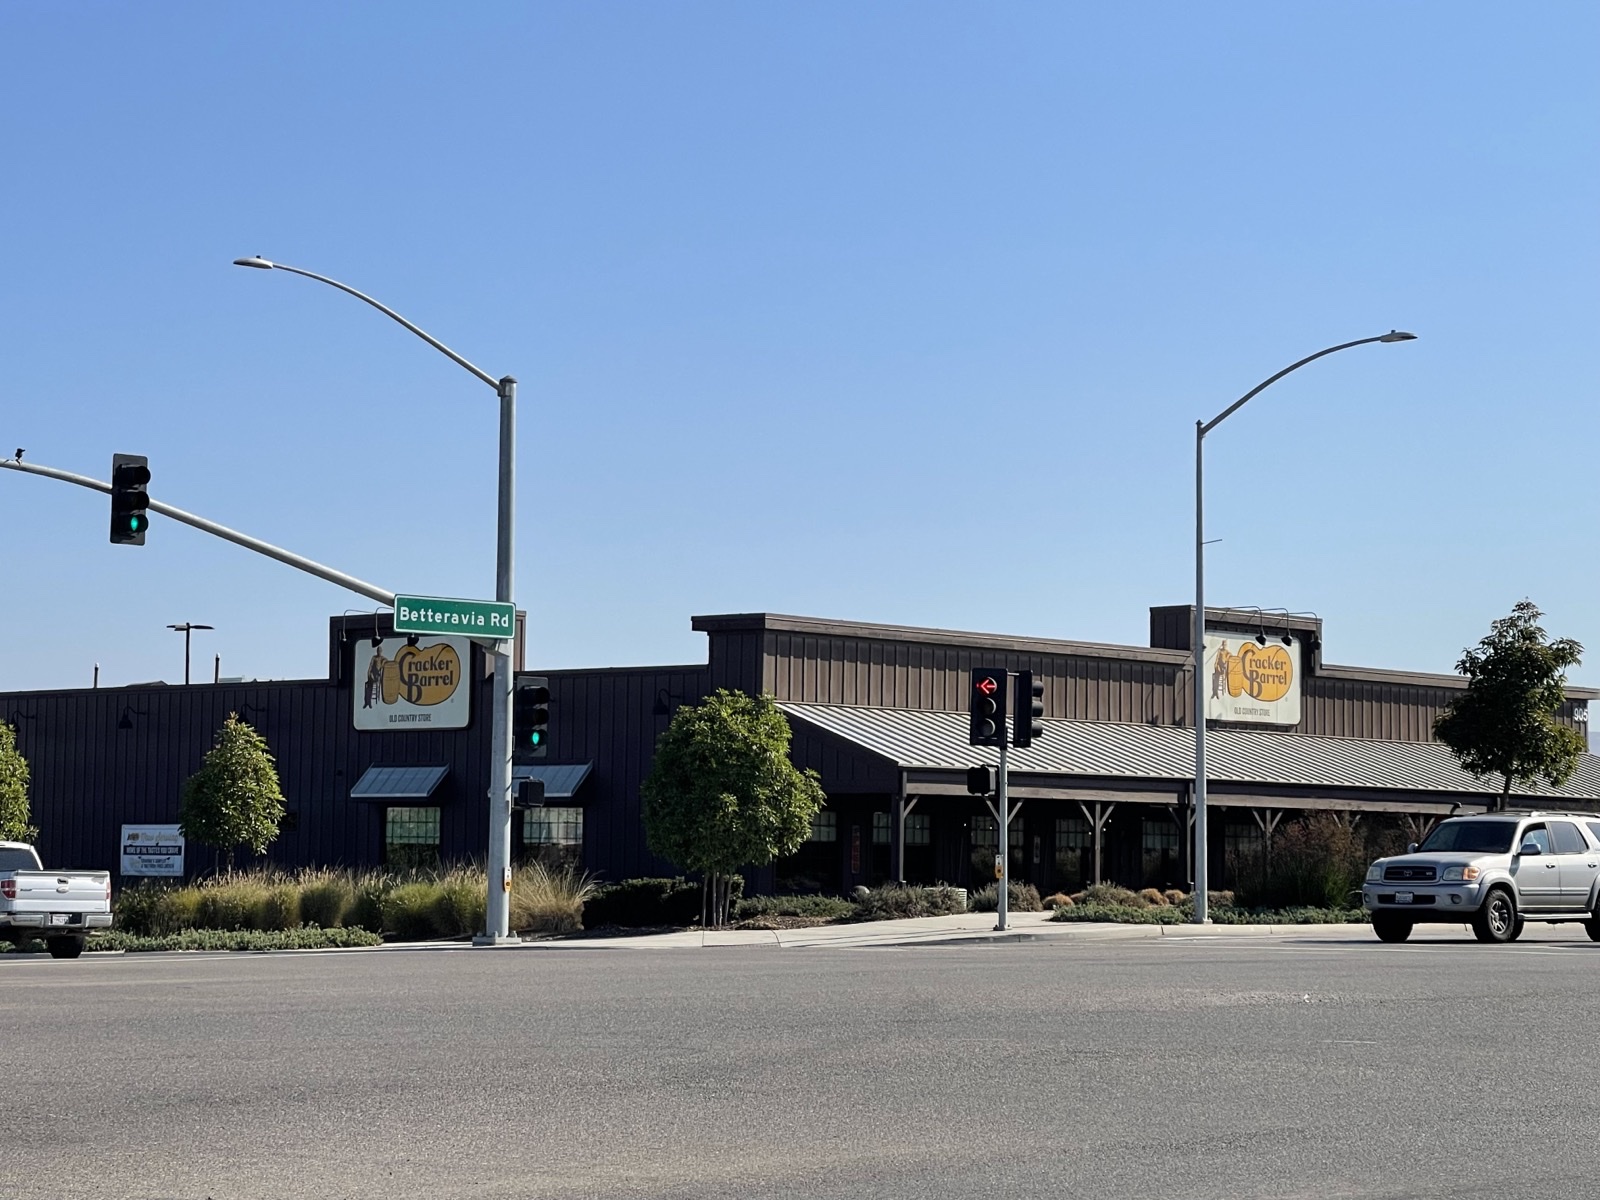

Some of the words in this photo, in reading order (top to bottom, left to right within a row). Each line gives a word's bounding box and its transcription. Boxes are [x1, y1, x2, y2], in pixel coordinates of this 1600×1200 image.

[400, 606, 485, 626] Betteravia
[490, 612, 509, 627] Rd
[399, 651, 453, 686] Cracker
[1241, 648, 1287, 682] Cracker
[407, 670, 454, 703] Barrel
[1249, 669, 1287, 698] Barrel
[418, 713, 431, 722] STORE
[1574, 707, 1588, 722] 905
